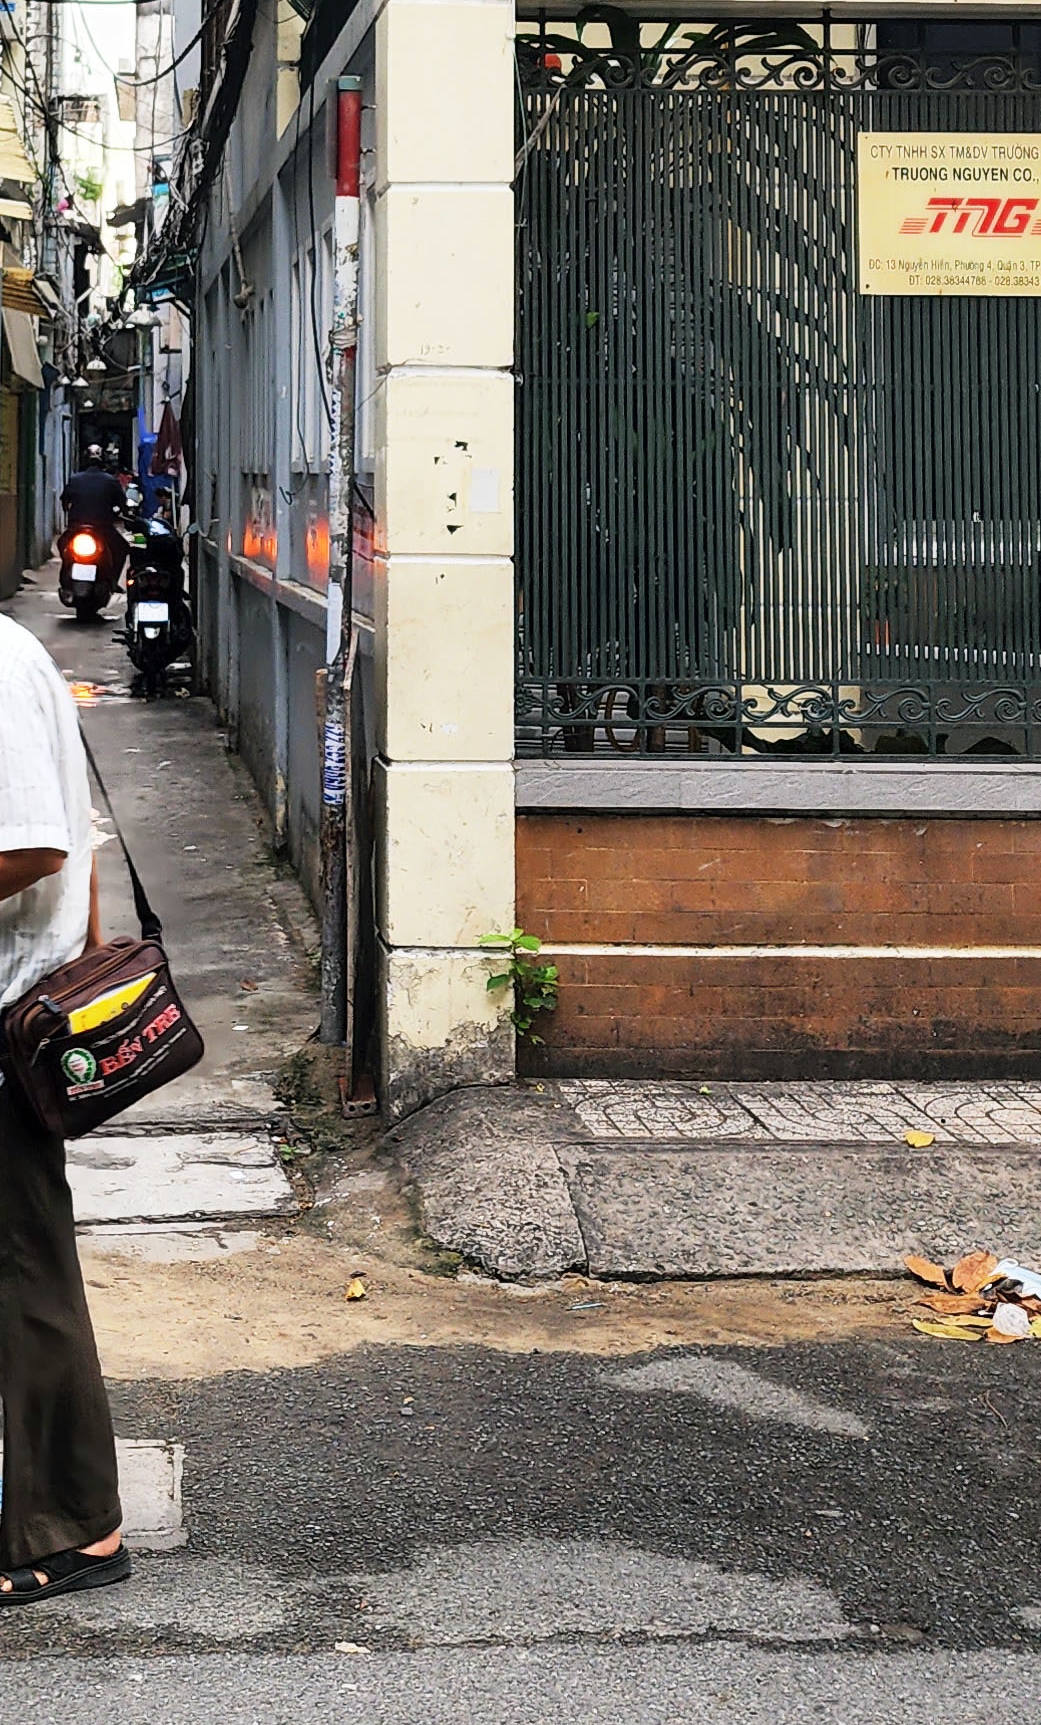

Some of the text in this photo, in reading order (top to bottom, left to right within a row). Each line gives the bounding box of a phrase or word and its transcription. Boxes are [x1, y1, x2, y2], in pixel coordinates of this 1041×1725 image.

[870, 145, 893, 159] CTY
[896, 145, 927, 159] TNHH
[931, 145, 946, 159] SX
[949, 146, 989, 159] TM&DV
[892, 167, 1040, 185] TRUONG NGUYEN CO.,
[886, 259, 896, 270] 13
